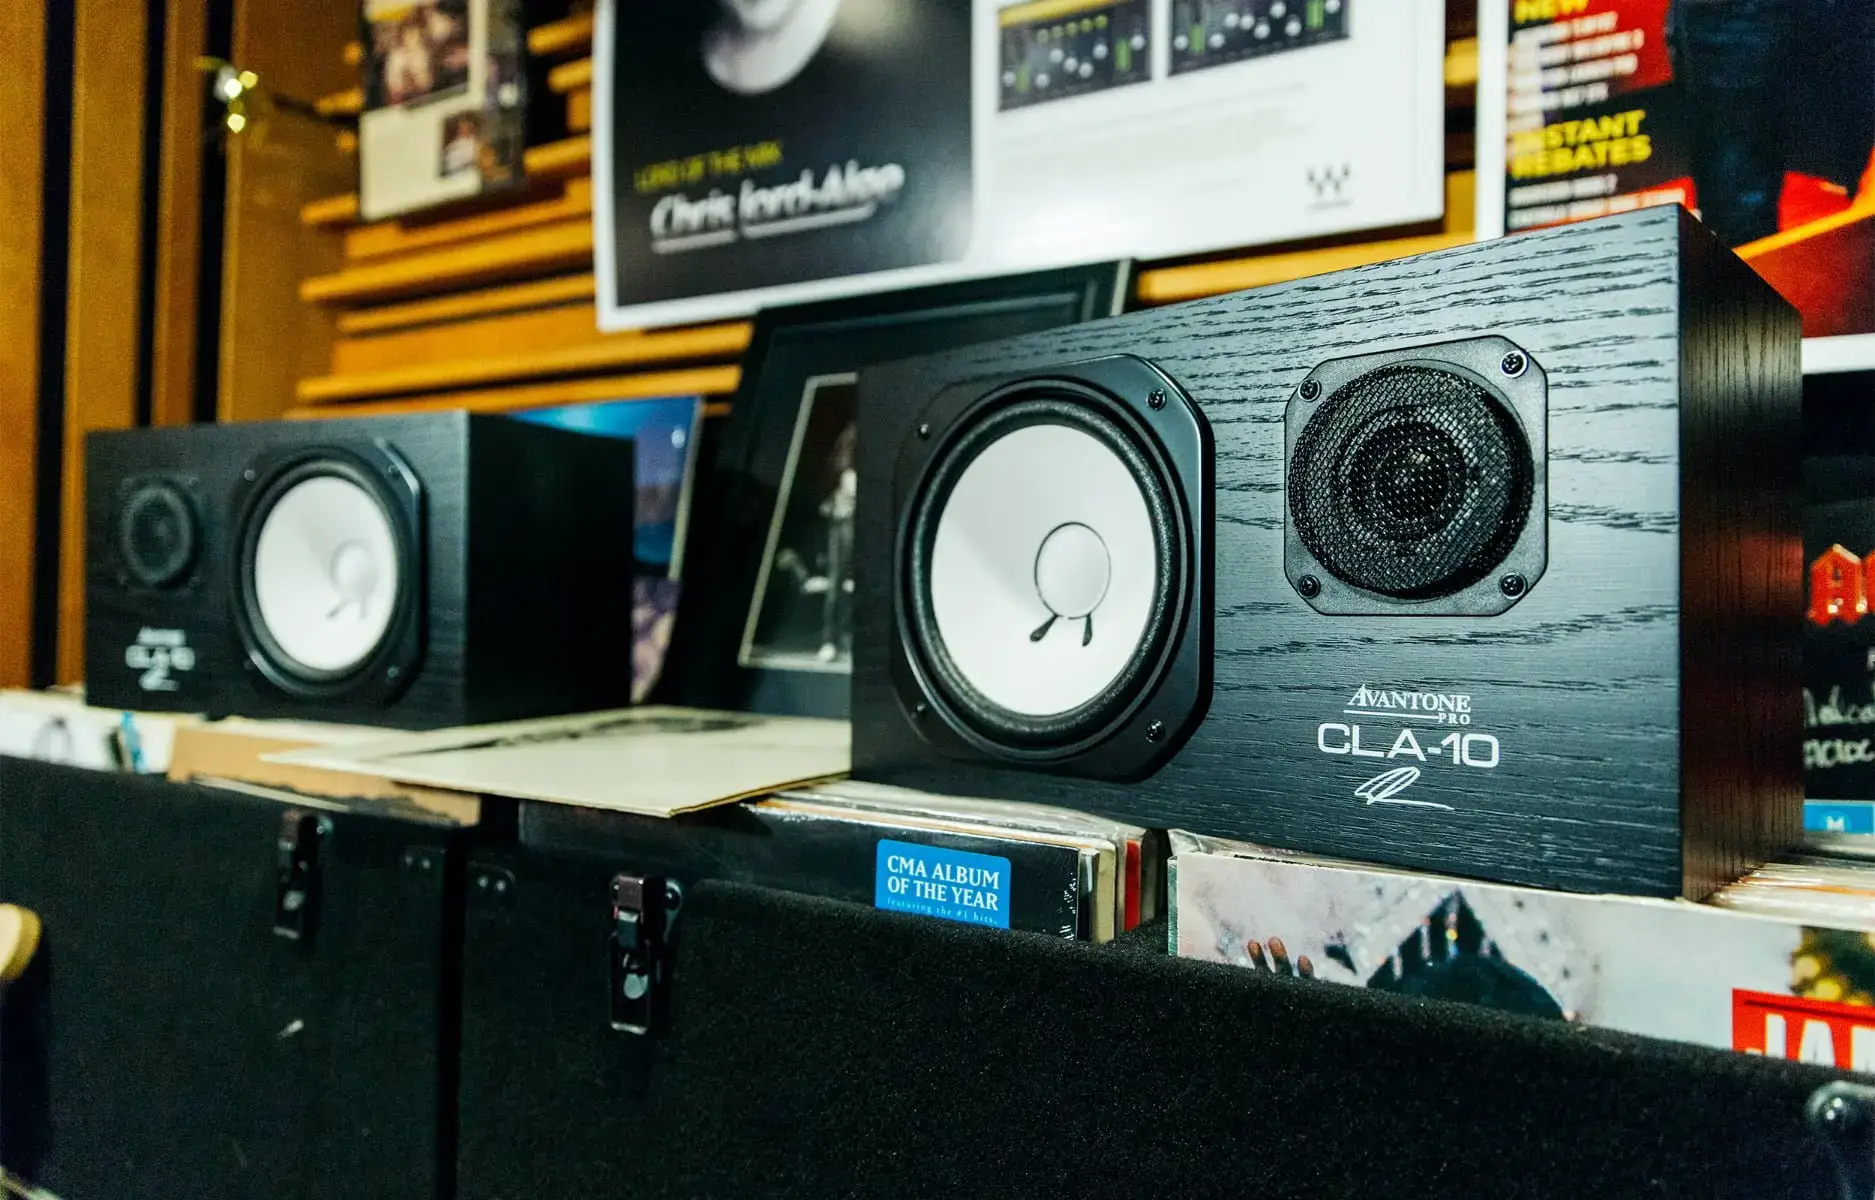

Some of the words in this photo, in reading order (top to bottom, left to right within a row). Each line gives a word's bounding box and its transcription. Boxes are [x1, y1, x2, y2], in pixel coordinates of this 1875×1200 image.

[1511, 134, 1651, 180] REBATES
[650, 191, 737, 236] Chris
[1347, 684, 1472, 713] AVANTONE
[1438, 712, 1471, 725] PRO
[1317, 722, 1500, 769] CLA-10
[887, 855, 927, 878] CMA
[932, 863, 1000, 890] ALBUM
[887, 875, 910, 895] OF
[913, 880, 947, 902] THE
[951, 886, 999, 912] YEAR
[936, 905, 952, 917] the
[956, 909, 968, 919] #1
